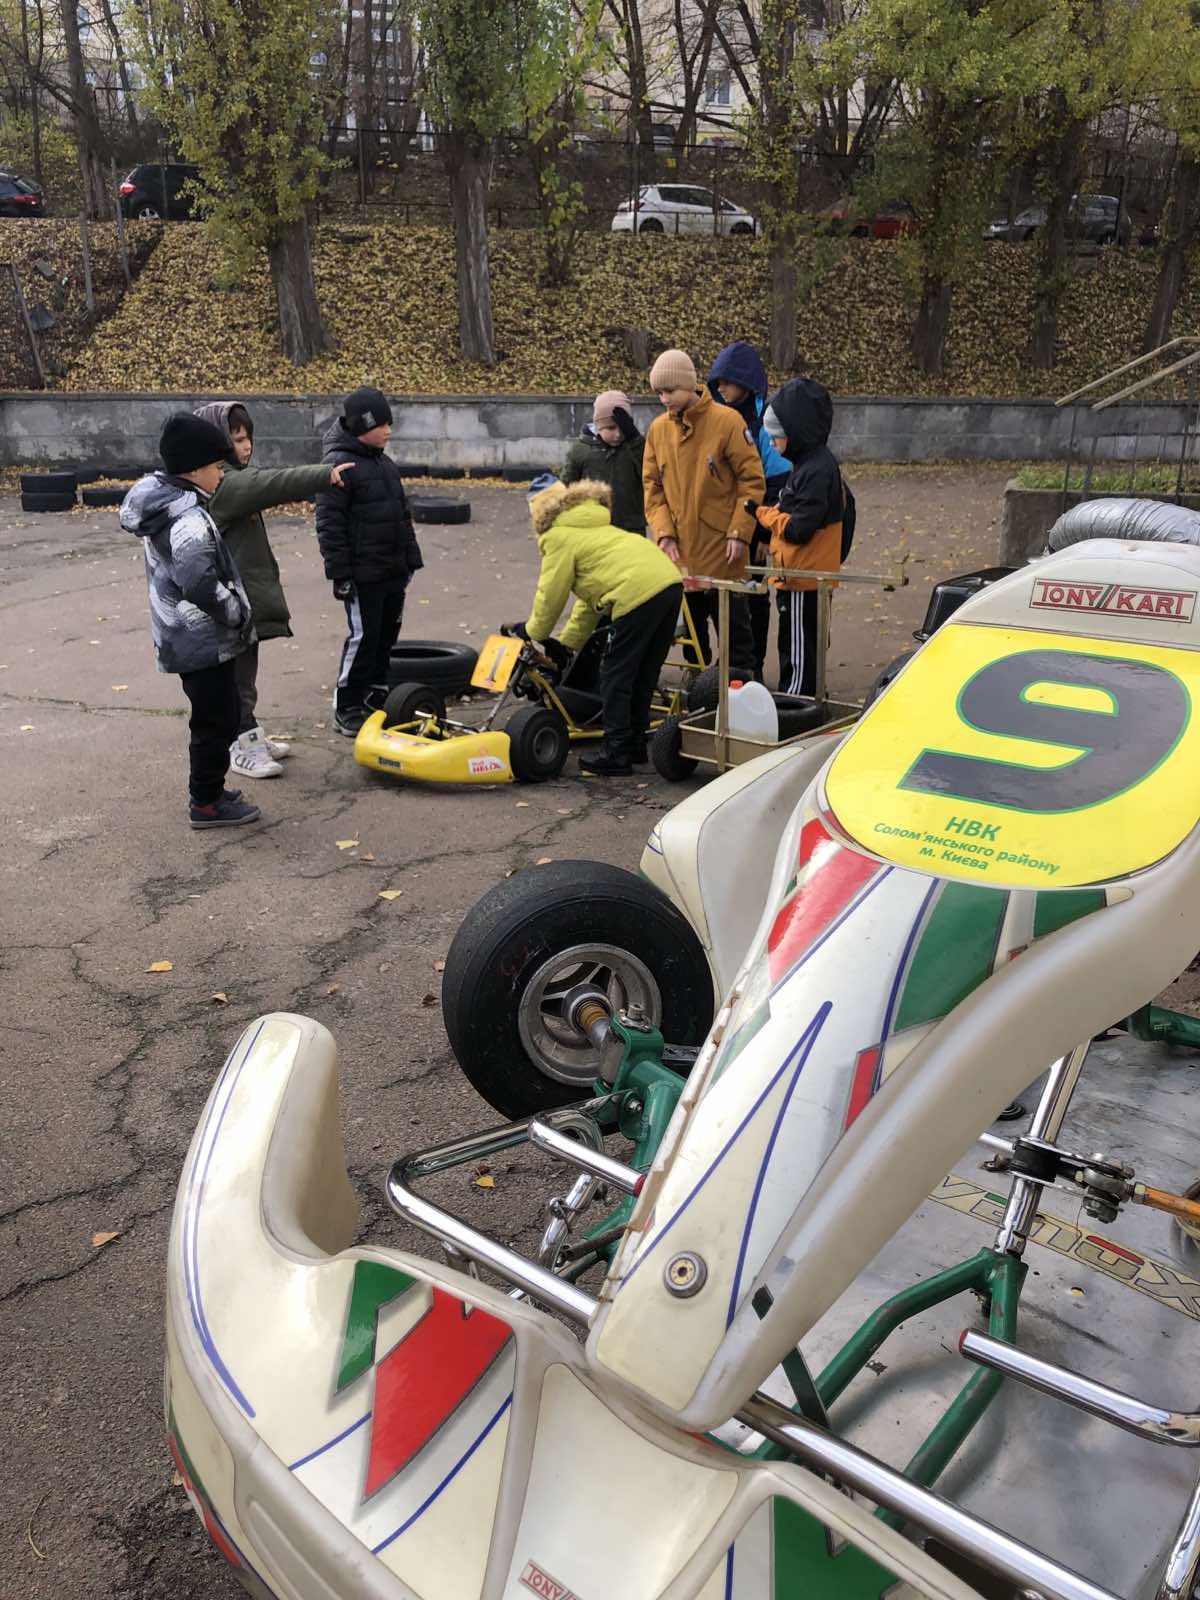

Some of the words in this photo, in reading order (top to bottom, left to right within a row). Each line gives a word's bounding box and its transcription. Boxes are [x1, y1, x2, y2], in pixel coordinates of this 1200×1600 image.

[896, 647, 1193, 816] 9
[944, 816, 1003, 842] НВК
[918, 847, 936, 858] м.
[941, 850, 989, 871] Києва
[996, 851, 1061, 876] району
